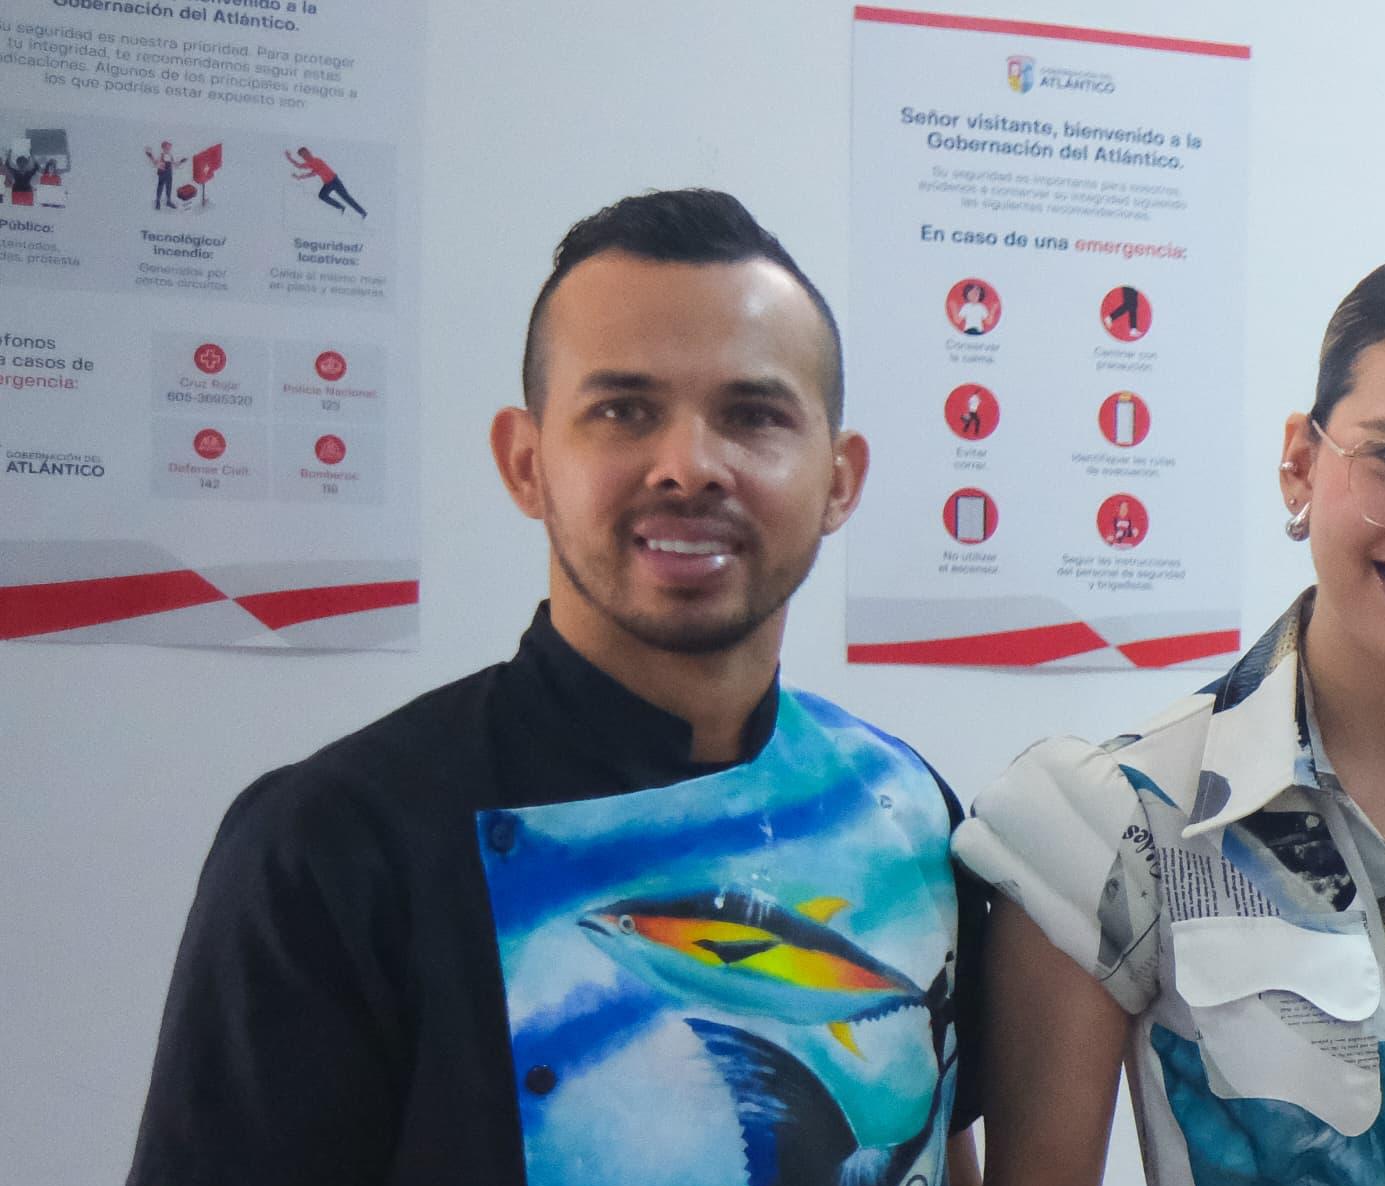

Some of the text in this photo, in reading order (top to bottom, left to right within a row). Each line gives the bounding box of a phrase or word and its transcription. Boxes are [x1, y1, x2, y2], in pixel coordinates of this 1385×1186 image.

[286, 3, 297, 12] a
[302, 1, 317, 14] la
[179, 7, 207, 21] del
[213, 9, 300, 31] Atlántico.
[16, 22, 93, 41] seguridad
[98, 32, 115, 43] es
[121, 35, 178, 49] nuestra
[257, 46, 289, 60] Para
[294, 52, 356, 69] proteger
[8, 37, 23, 49] tu
[116, 51, 131, 61] te
[136, 54, 250, 72] recomendamos
[255, 65, 298, 78] seguir
[303, 70, 342, 82] estas
[44, 72, 66, 85] los
[71, 76, 100, 89] que
[104, 79, 160, 95] podrías
[165, 84, 203, 98] estar
[208, 89, 275, 106] expuesto
[95, 62, 156, 79] Algunos
[161, 69, 180, 81] de
[184, 71, 205, 83] los
[210, 73, 288, 92] principales
[293, 82, 345, 97] riesgos
[349, 90, 358, 99] a
[1040, 75, 1116, 94] ATLÁNTICO
[901, 106, 1203, 149] Señor visitante, bienvenido a la
[927, 131, 1185, 169] Gobernación del Atlántico.
[0, 219, 54, 233] Público:
[140, 230, 228, 247] Tecnológico/
[293, 237, 364, 253] Seguridad/
[921, 224, 1188, 260] En caso de una emergencia:
[153, 245, 214, 260] incendio:
[208, 267, 228, 280] por
[177, 278, 229, 291] circuitos
[12, 355, 66, 369] casos
[72, 358, 95, 371] de
[179, 377, 207, 390] Cruz
[6, 451, 81, 463] GOBERNACIÓN
[6, 459, 105, 477] ATLÁNTICO
